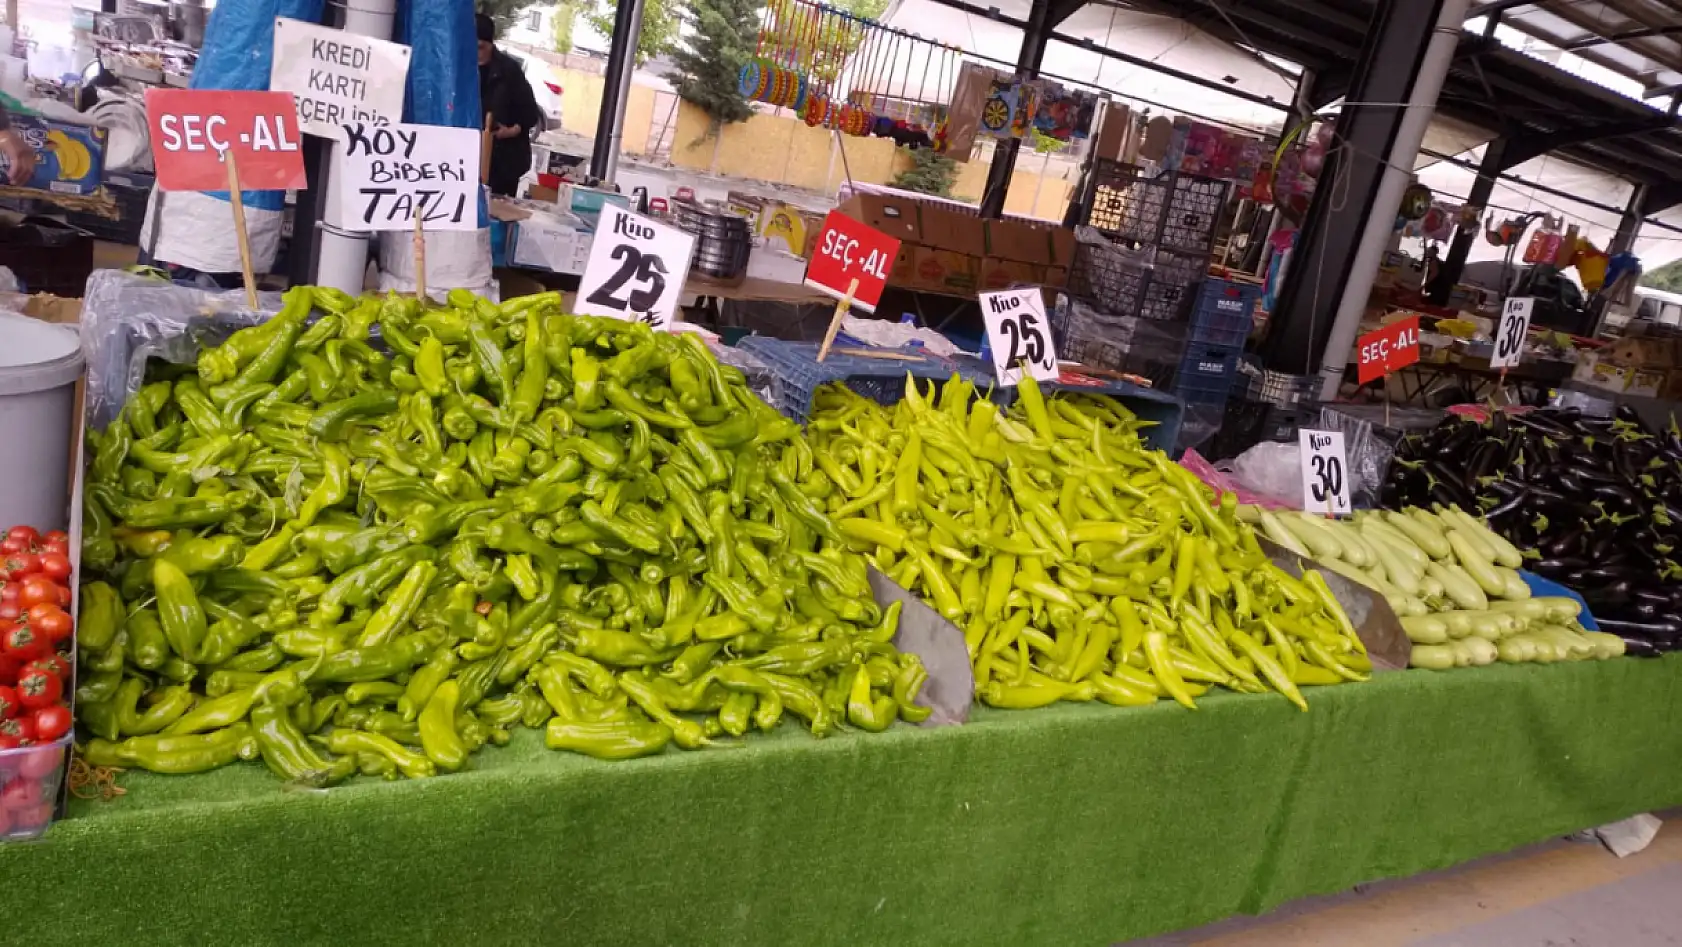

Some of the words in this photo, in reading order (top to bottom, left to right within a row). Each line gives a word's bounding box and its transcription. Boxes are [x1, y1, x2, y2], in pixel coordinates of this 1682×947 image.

[311, 37, 371, 71] KREDİ
[308, 68, 366, 101] KARTI
[359, 188, 466, 224] TATLI
[586, 243, 670, 313] 25
[1000, 313, 1045, 370] 25
[1499, 315, 1525, 358] 30
[1311, 454, 1342, 502] 30
